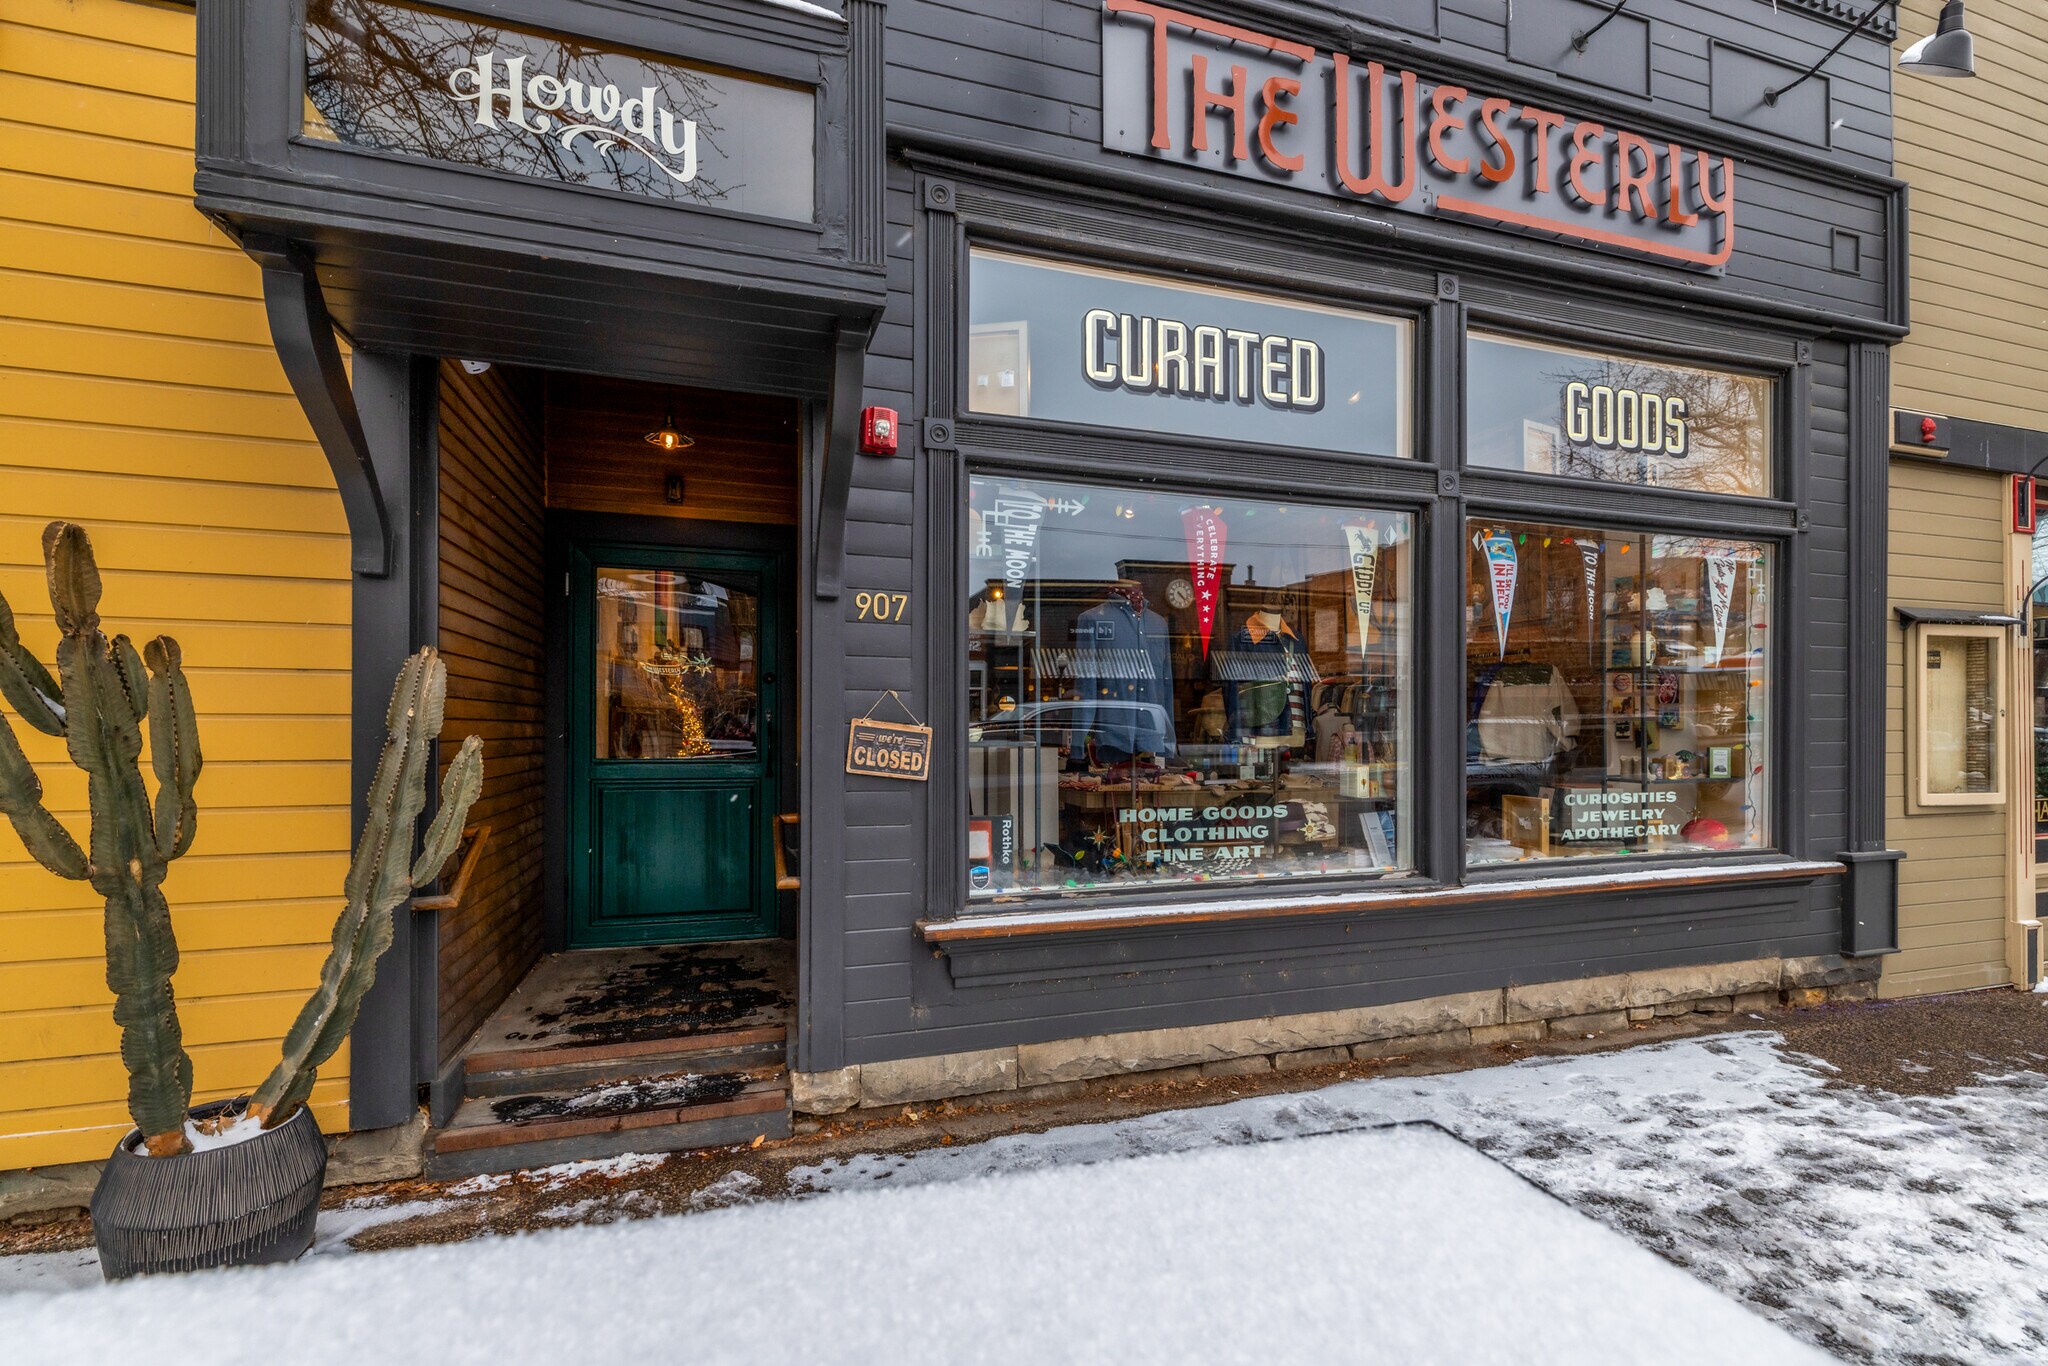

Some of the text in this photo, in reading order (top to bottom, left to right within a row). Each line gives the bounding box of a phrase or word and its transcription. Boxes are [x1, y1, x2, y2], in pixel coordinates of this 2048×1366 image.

[448, 51, 698, 183] Howdy
[1083, 308, 1325, 413] CURATED
[1563, 381, 1689, 458] GOODS
[1002, 502, 1043, 589] TO THE MOON
[1205, 518, 1219, 580] CELEBRATE
[1353, 552, 1375, 615] GIDDY UP
[1493, 563, 1506, 609] IN HELL
[1505, 578, 1513, 592] SKI
[1583, 550, 1598, 620] TO THE MOON
[855, 592, 908, 622] 907
[1503, 592, 1512, 610] YOU
[878, 733, 904, 745] we're
[854, 746, 923, 772] CLOSED
[1563, 790, 1678, 806] CURIOSITIES
[1119, 804, 1289, 823] HOME GOODS
[1577, 808, 1666, 823] JEWELRY
[1002, 819, 1012, 864] Rothko
[1141, 824, 1270, 843] CLOTHING
[1560, 823, 1681, 841] APOTHECARY
[1146, 845, 1265, 863] FINE ART
